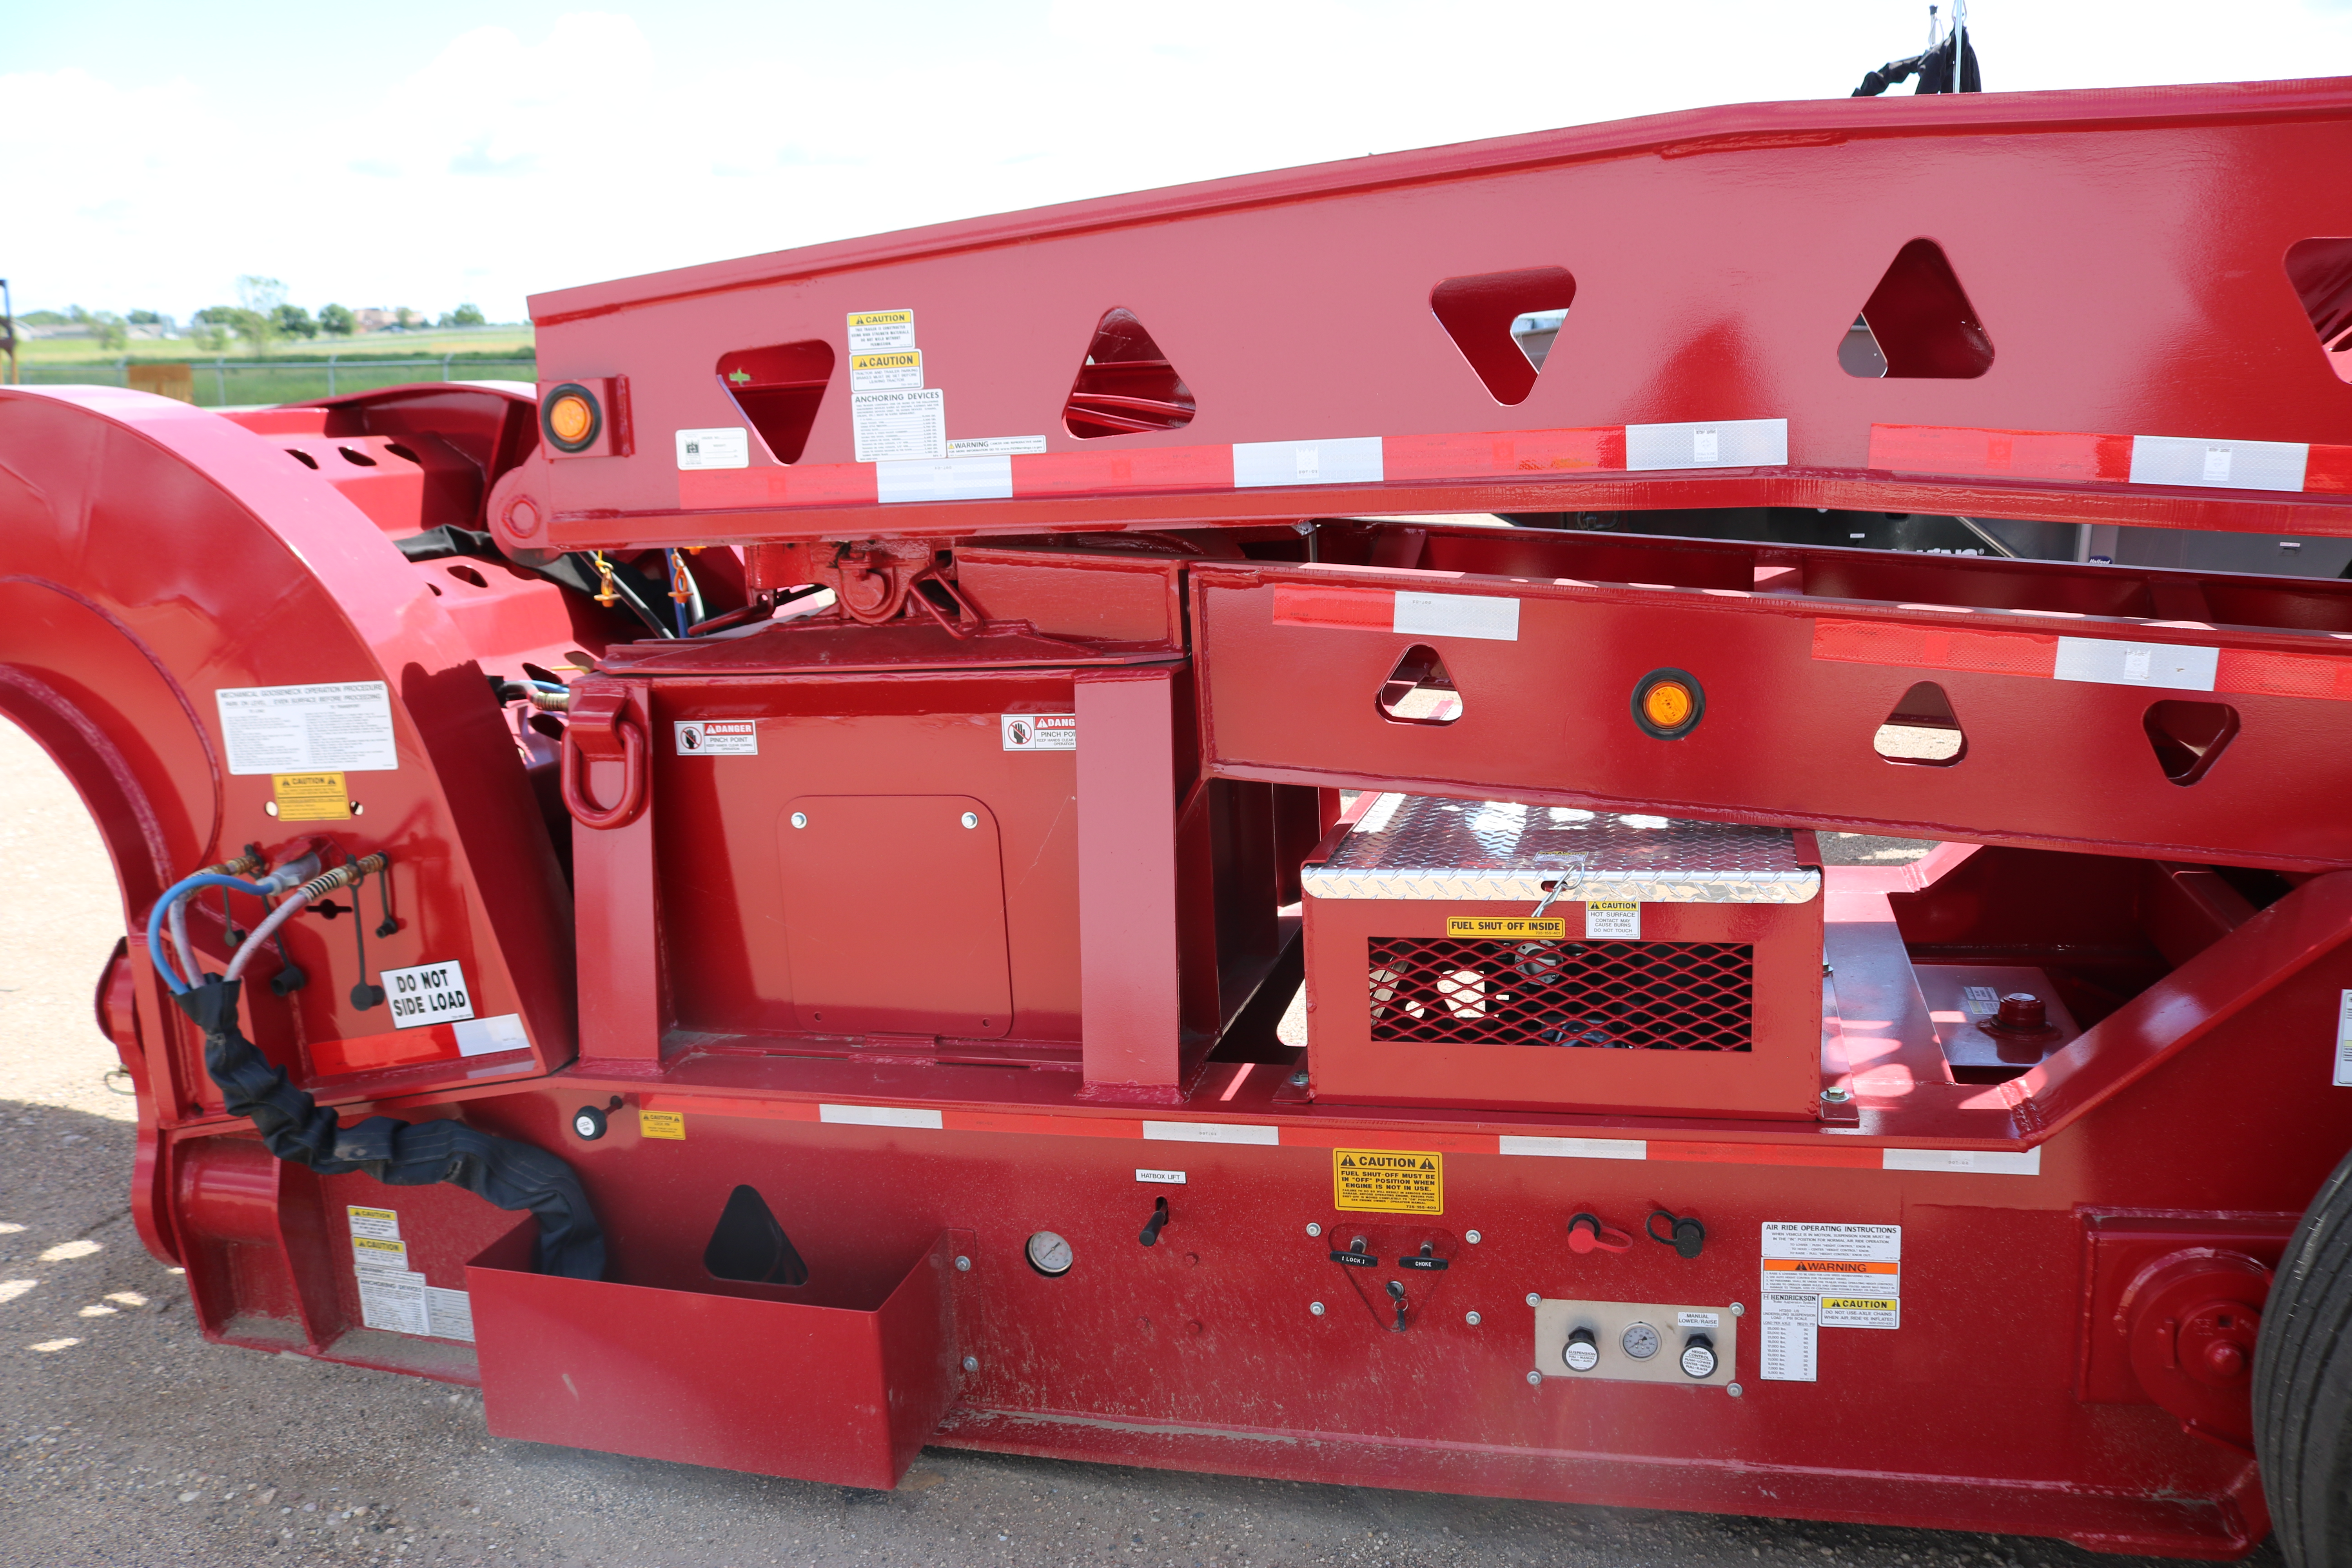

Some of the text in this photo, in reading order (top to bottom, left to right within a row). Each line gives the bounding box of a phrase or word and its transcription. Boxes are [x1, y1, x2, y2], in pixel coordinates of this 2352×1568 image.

[866, 314, 905, 323] CAUTION
[869, 355, 913, 366] CAUTION
[855, 392, 939, 403] ANCHORING DEVICES
[292, 777, 325, 785] CAUTION
[1451, 921, 1560, 931] FUEL SHUT-OFF INSIDE
[396, 969, 448, 993] DO NOT
[394, 991, 466, 1016] SIDE LOAD
[1359, 1156, 1415, 1167] CAUTION
[362, 1210, 391, 1219] CAUTION
[367, 1241, 399, 1251] CAUTION
[1808, 1262, 1867, 1272] WARNING
[360, 1280, 395, 1289] ANCHORING
